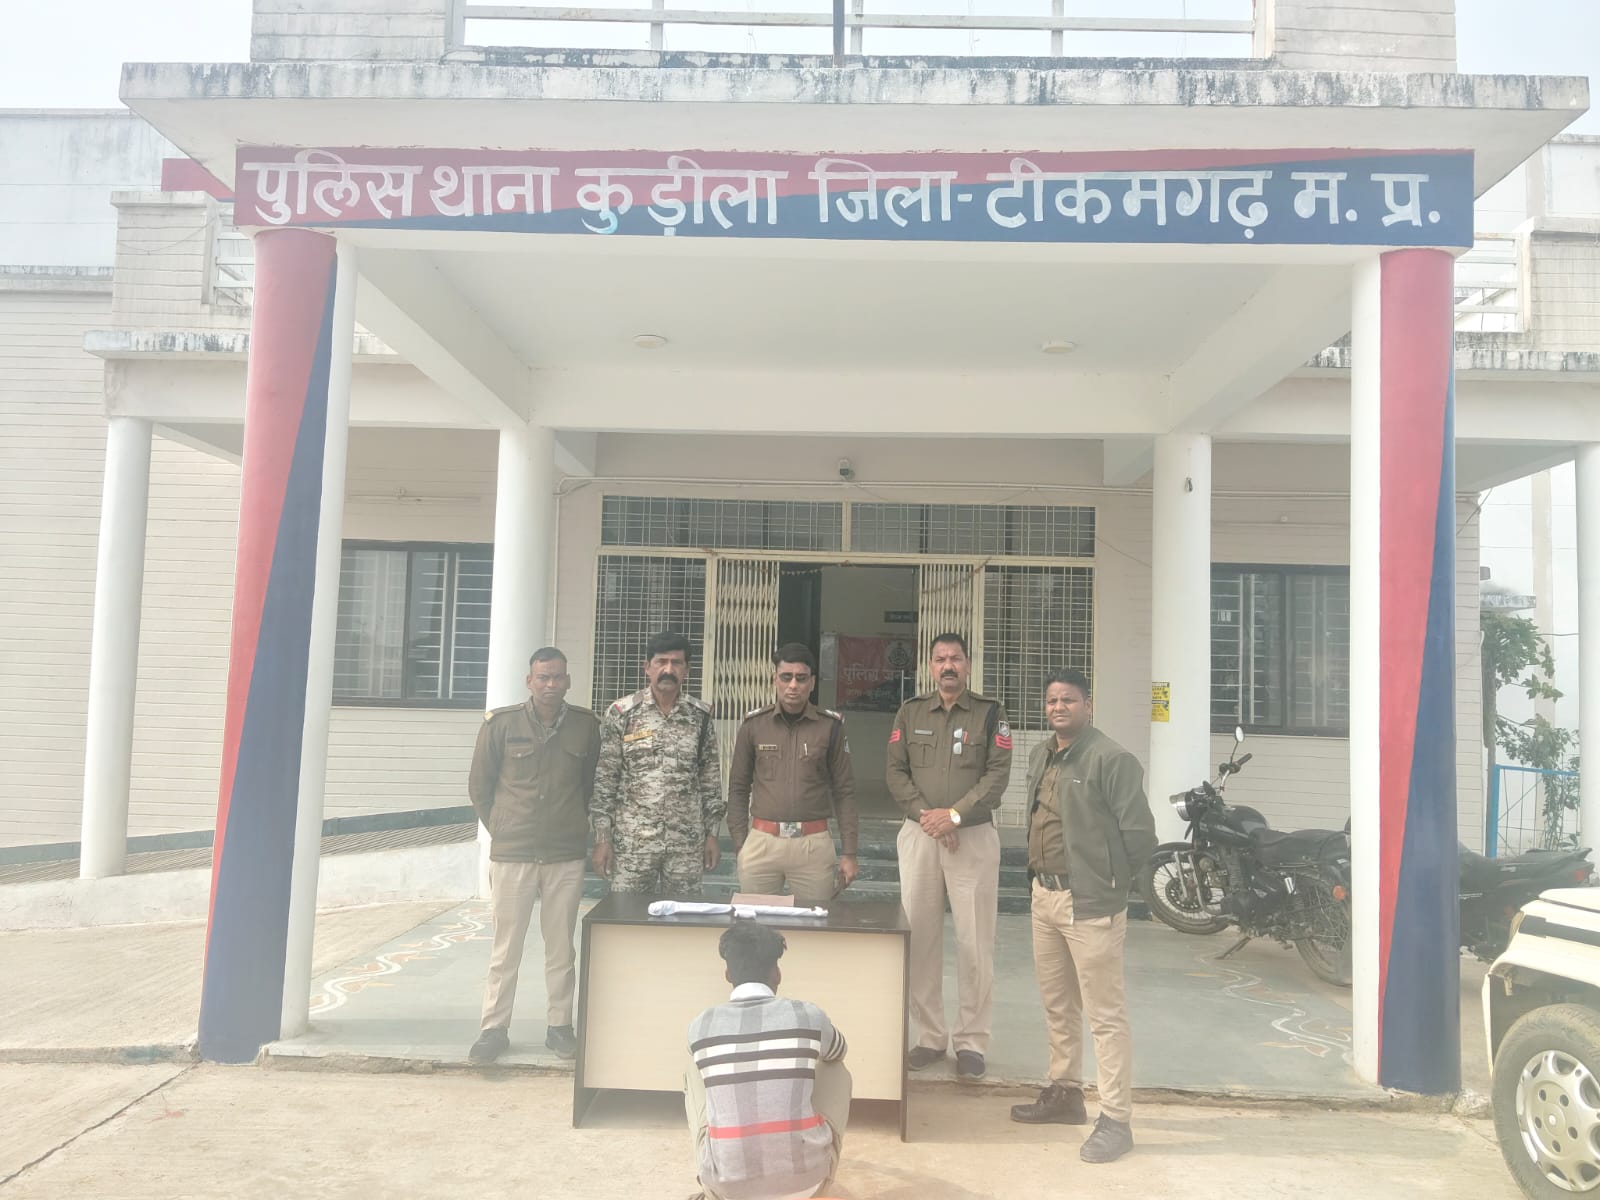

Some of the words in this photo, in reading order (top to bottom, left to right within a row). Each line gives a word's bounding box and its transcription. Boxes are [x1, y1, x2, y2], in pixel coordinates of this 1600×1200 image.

[243, 149, 424, 225] पुलिस
[429, 165, 561, 218] थाना
[574, 155, 789, 236] कुड़ीला
[986, 157, 1273, 240] टीकमगढ़
[1290, 171, 1358, 222] म.
[1370, 173, 1441, 228] प्र.
